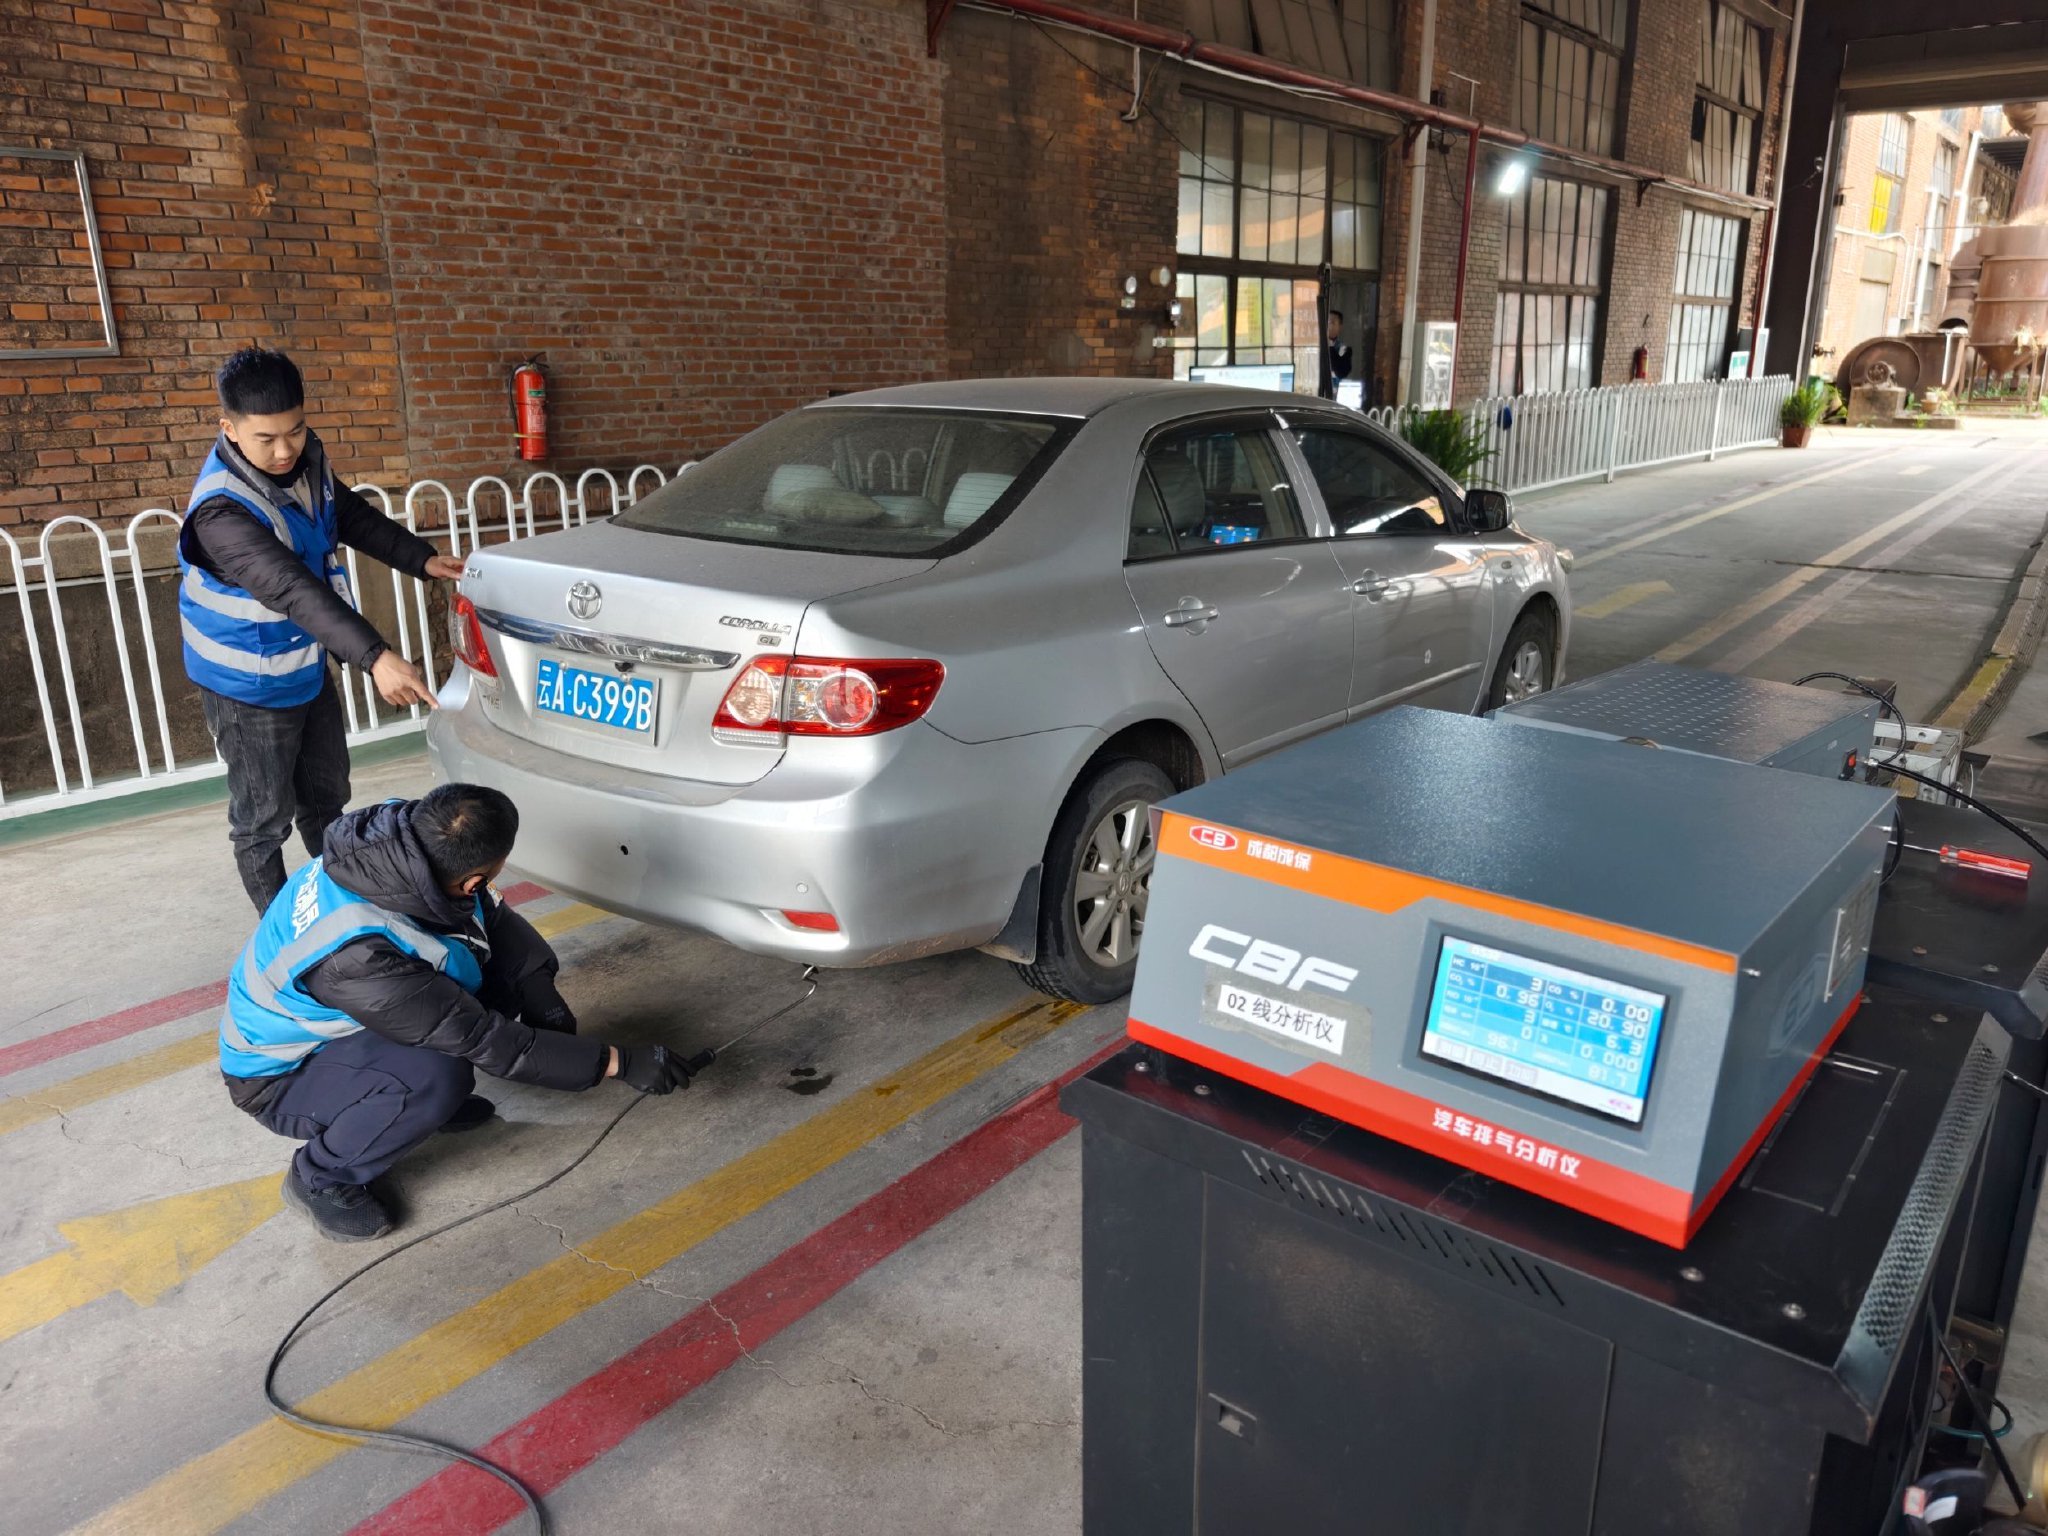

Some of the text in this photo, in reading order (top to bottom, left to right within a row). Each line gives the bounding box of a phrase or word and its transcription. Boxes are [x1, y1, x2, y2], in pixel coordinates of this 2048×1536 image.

[759, 635, 777, 646] GL
[1189, 924, 1359, 991] CBF
[1531, 977, 1543, 992] 3
[1251, 998, 1334, 1043] 线分析仪
[1524, 1009, 1536, 1025] 3
[1602, 998, 1649, 1022] 0.00
[1520, 1025, 1532, 1040] 0
[1587, 1010, 1645, 1039] 20.90
[1606, 1034, 1642, 1056] 6.3
[1580, 1044, 1638, 1073] 0.000
[1432, 1107, 1581, 1179] 汽车排气分析仪
